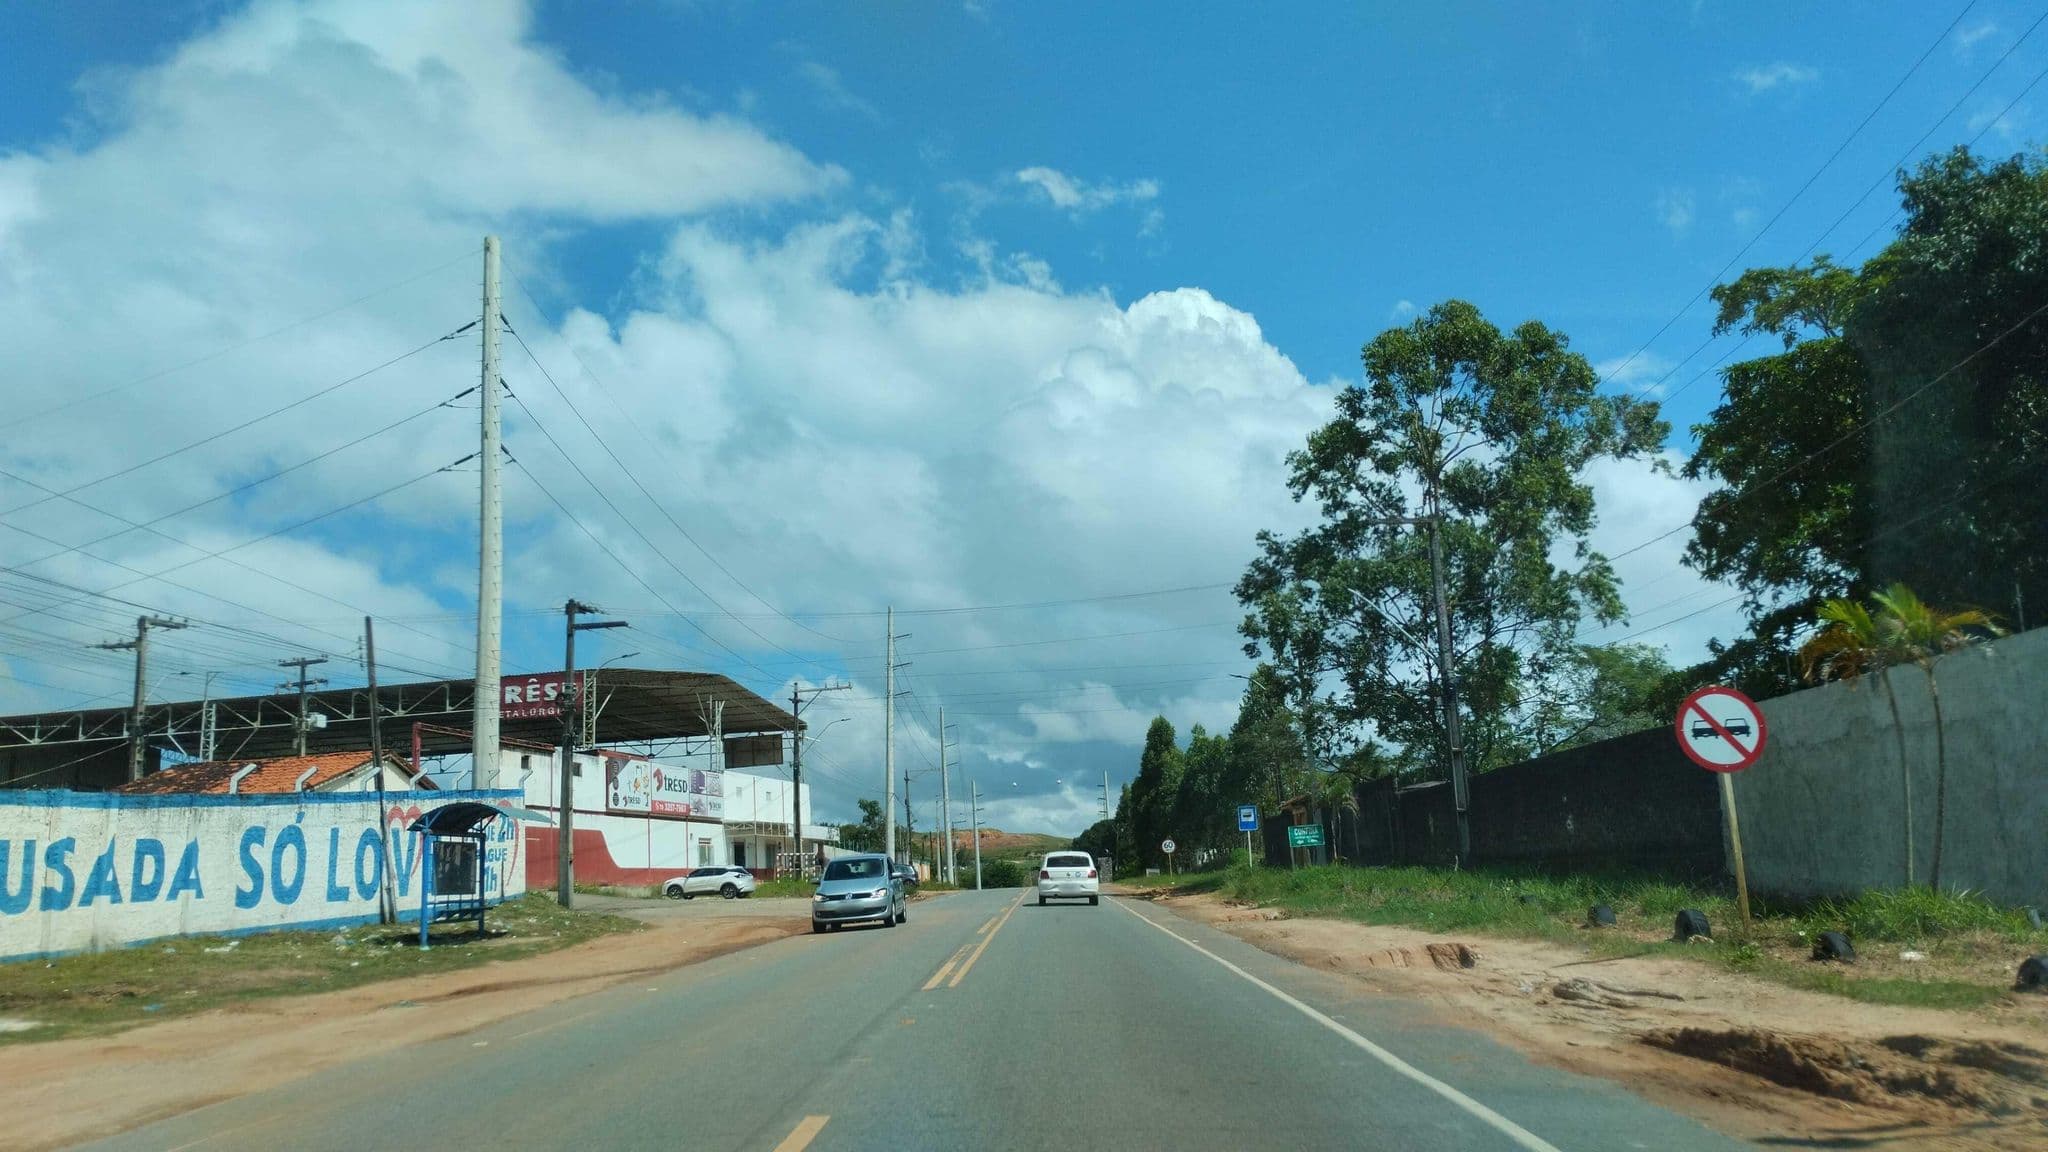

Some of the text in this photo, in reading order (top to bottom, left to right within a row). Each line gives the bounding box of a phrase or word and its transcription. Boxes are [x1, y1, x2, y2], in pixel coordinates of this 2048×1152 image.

[0, 811, 438, 914] USADA SÓ LOV
